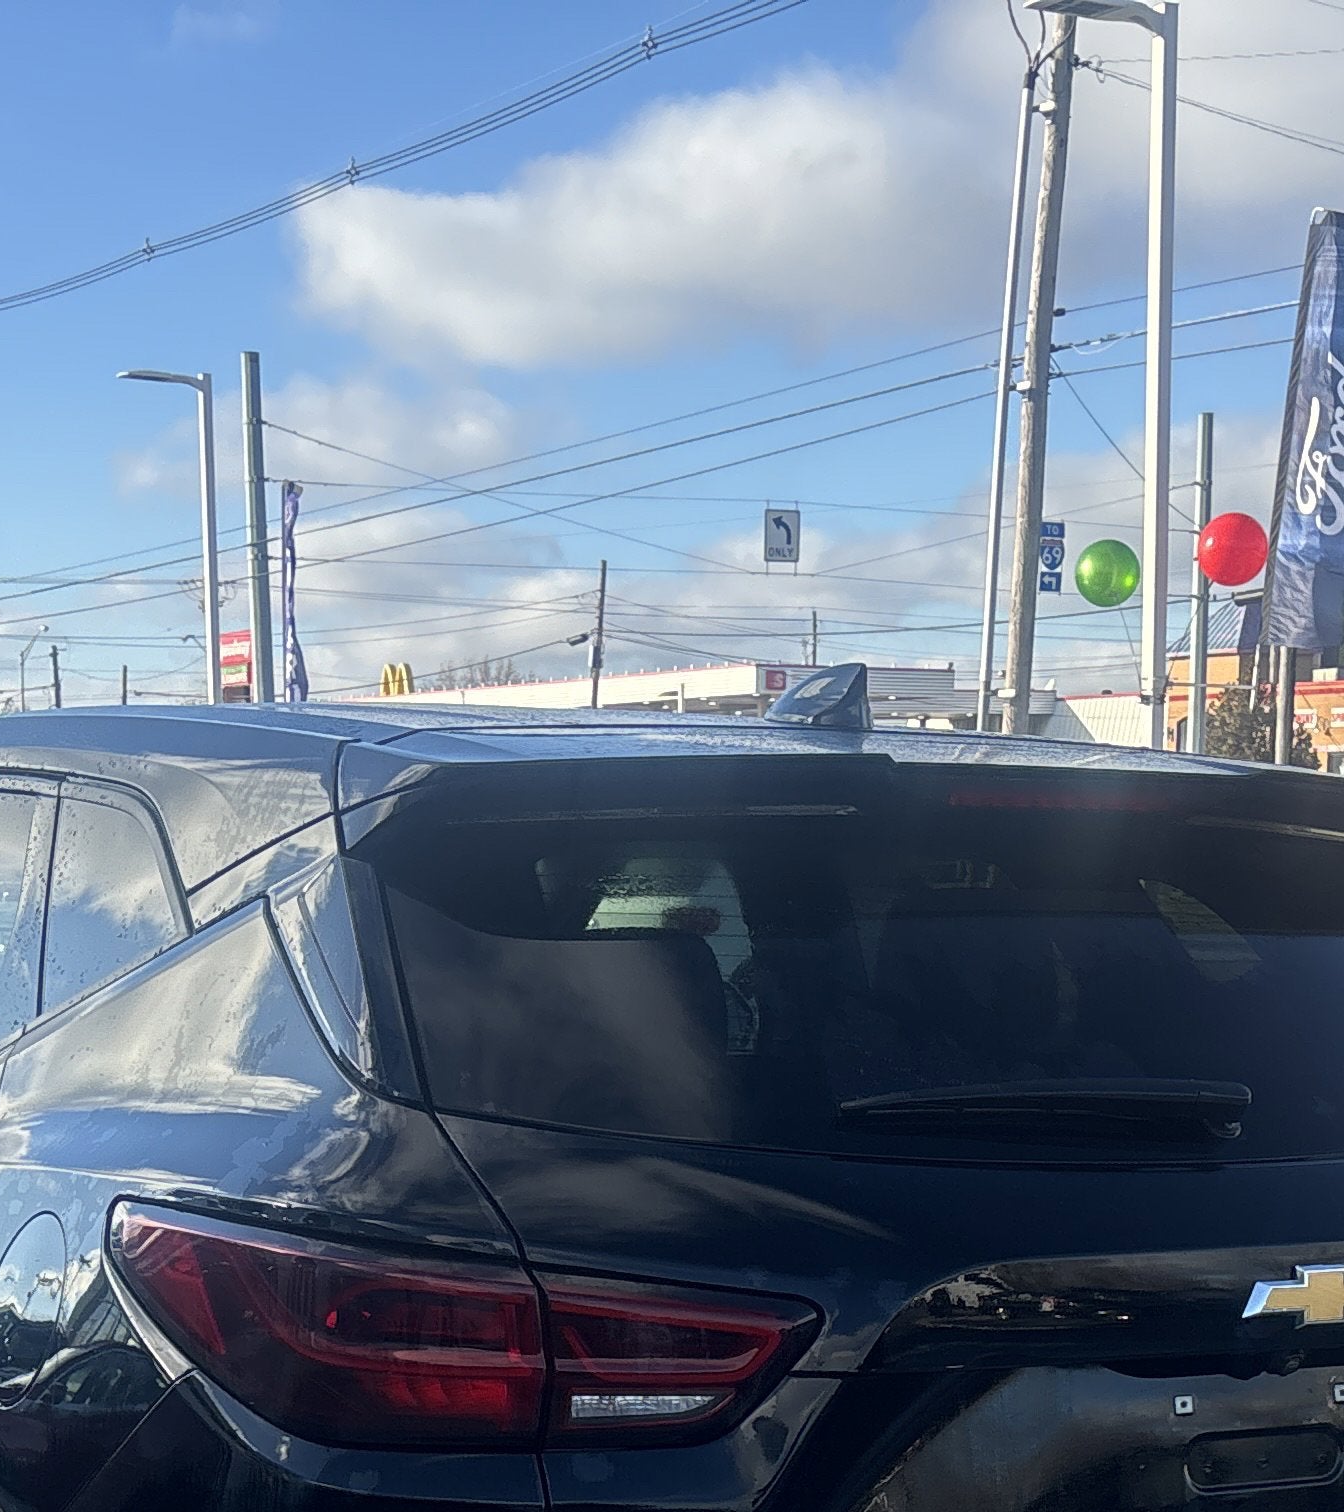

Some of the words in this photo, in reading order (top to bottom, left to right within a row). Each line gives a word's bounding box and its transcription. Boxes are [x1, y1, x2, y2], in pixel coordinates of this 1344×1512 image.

[1045, 524, 1060, 535] TO
[767, 546, 794, 558] ONLY
[1042, 546, 1063, 565] 69
